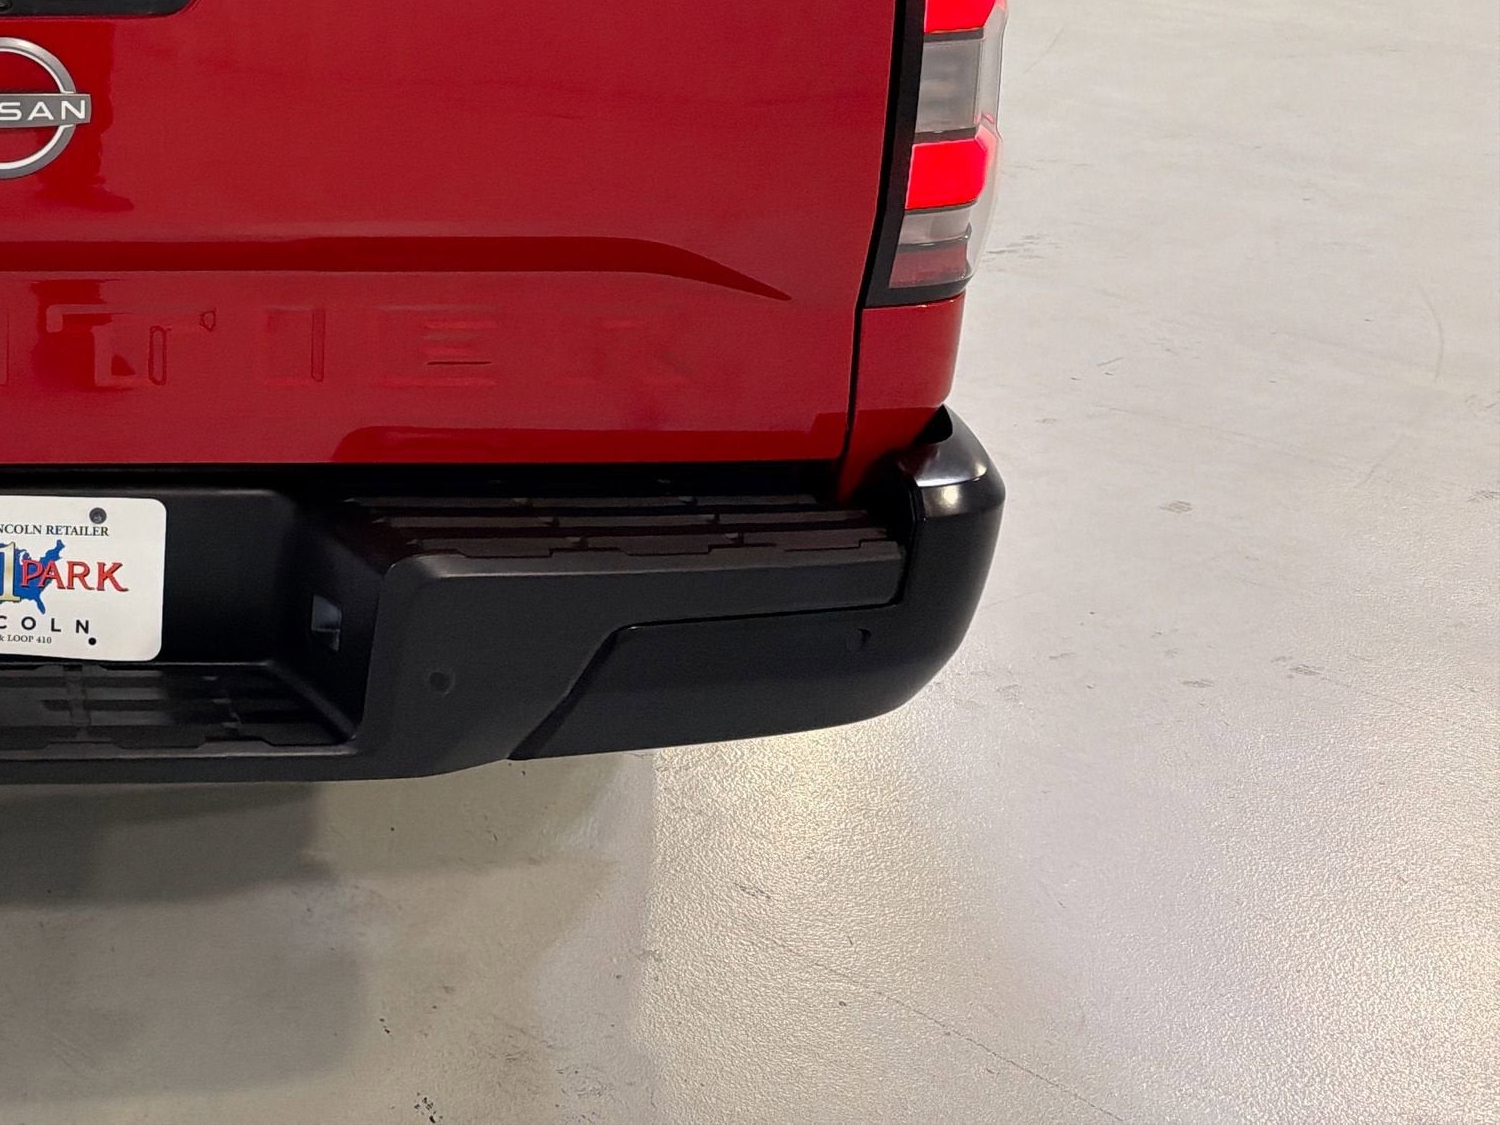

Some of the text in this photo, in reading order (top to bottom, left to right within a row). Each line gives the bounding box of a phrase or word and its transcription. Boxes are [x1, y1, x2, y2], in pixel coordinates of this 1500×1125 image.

[46, 525, 110, 537] RETAILER
[21, 559, 130, 593] PARK
[7, 634, 34, 643] LOOP
[36, 635, 52, 644] 410
